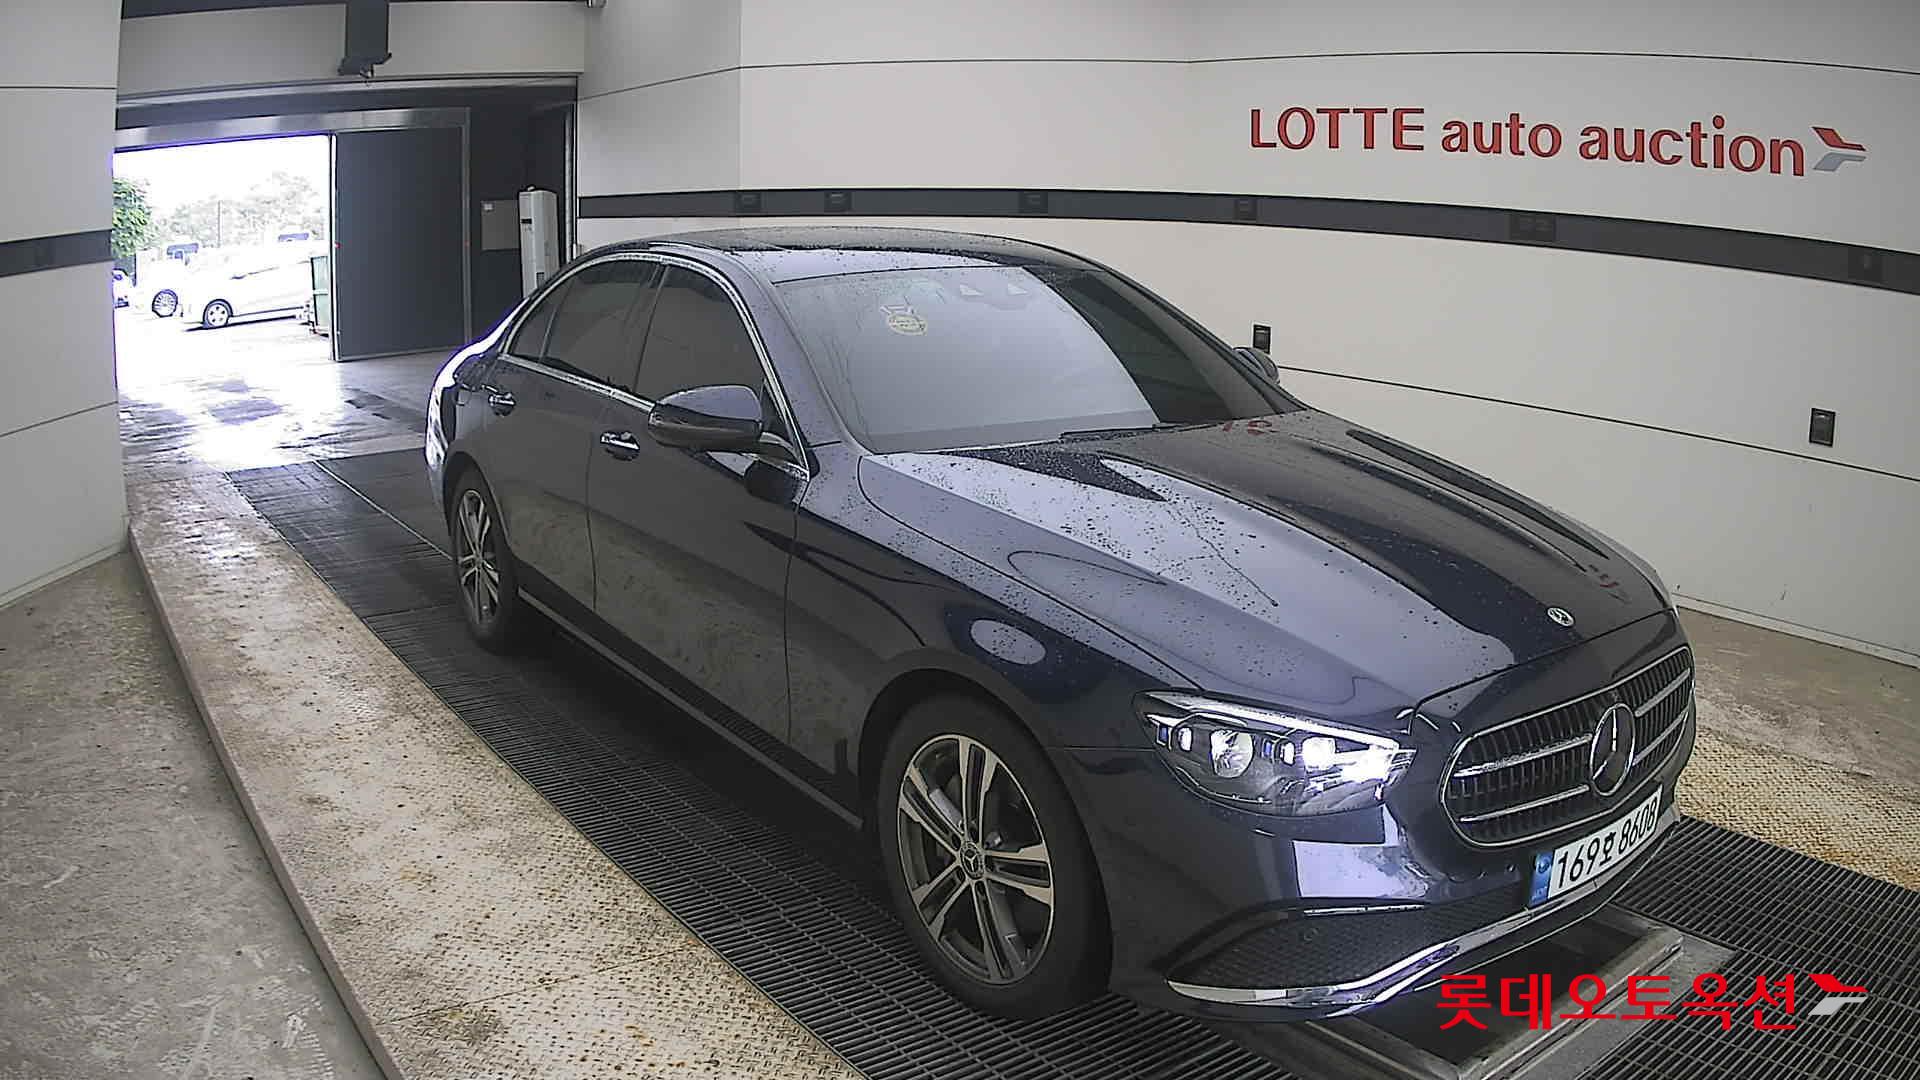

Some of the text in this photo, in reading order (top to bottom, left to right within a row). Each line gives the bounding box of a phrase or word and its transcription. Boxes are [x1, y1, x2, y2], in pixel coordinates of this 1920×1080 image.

[1250, 107, 1806, 177] LOTTE auto auction
[1618, 797, 1658, 854] 8608
